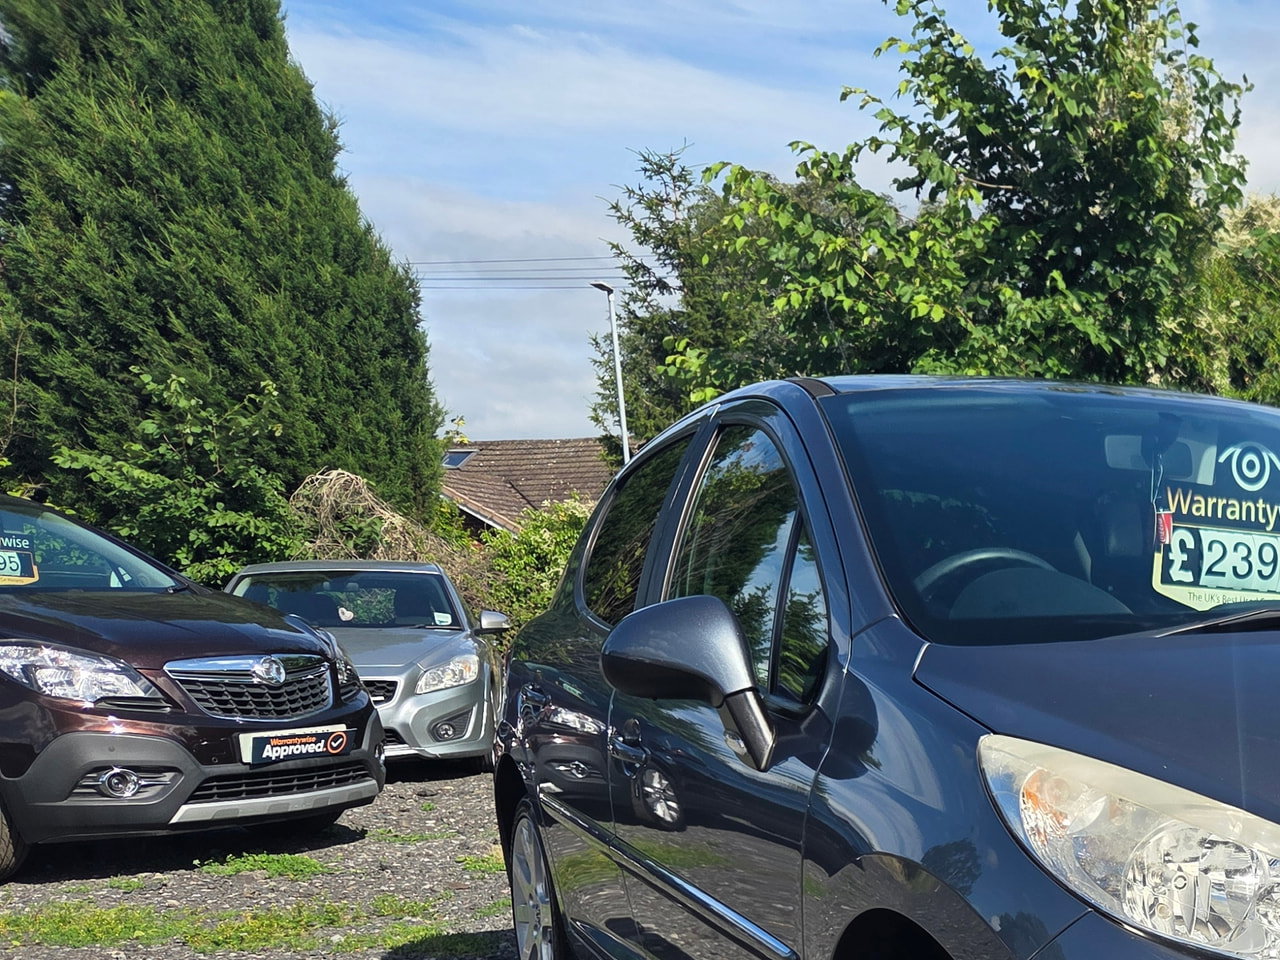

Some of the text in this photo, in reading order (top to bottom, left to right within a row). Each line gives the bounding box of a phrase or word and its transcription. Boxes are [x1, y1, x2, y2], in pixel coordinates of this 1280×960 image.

[0, 535, 30, 549] wise
[1188, 591, 1203, 602] The
[1204, 592, 1221, 603] UK's
[270, 736, 317, 746] Warrantywise
